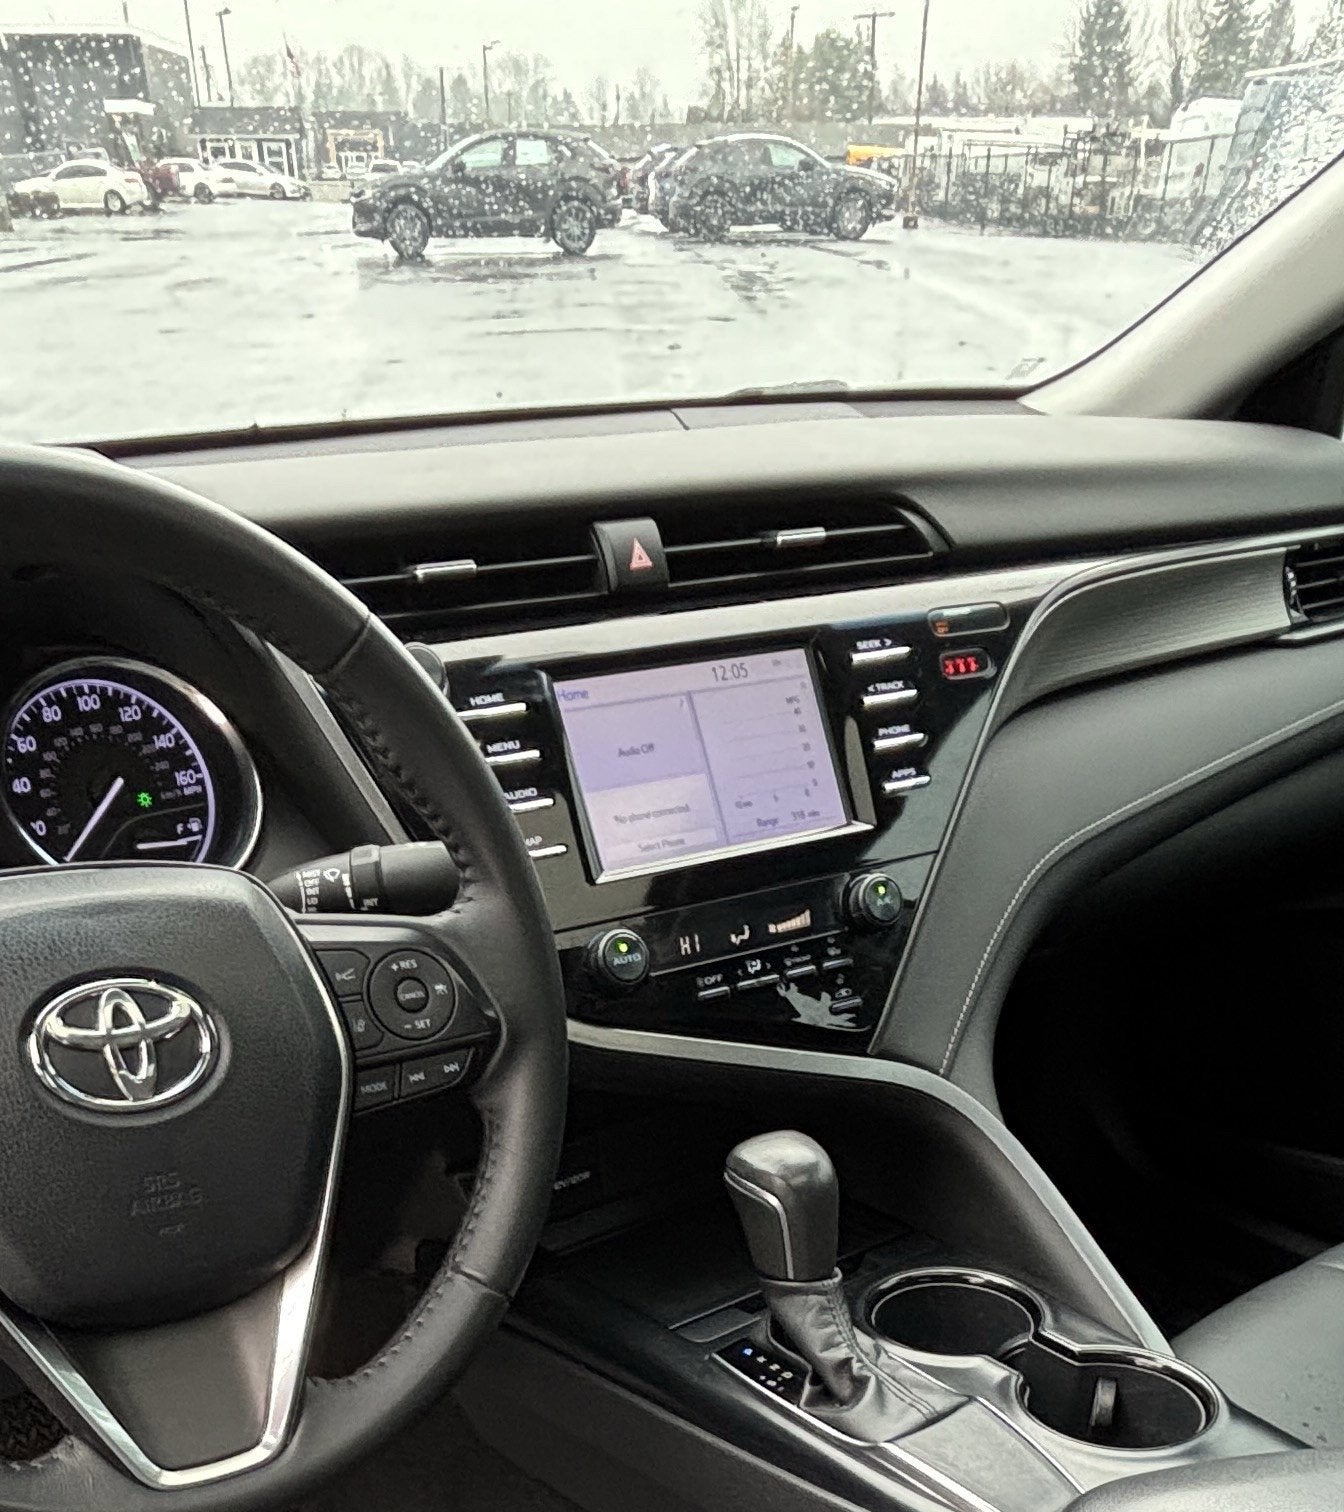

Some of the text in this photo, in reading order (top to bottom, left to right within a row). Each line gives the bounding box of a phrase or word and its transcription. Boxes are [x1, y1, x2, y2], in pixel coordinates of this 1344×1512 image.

[856, 639, 882, 650] SEEK
[876, 680, 904, 692] TRACK
[470, 692, 505, 707] HOME
[557, 687, 589, 702] Home
[77, 693, 102, 712] 100
[42, 705, 62, 723] 80
[118, 704, 142, 723] 120
[878, 724, 911, 737] PHONE
[16, 735, 38, 754] 60
[153, 732, 176, 750] 140
[486, 740, 521, 754] MENU
[175, 768, 197, 786] 160
[891, 768, 917, 780] APPS
[12, 776, 32, 794] 40
[504, 787, 538, 801] AUDIO
[177, 823, 185, 834] F
[679, 933, 701, 956] HI
[399, 959, 418, 971] RES
[612, 952, 642, 968] AUTO
[414, 1018, 432, 1030] SET
[361, 1081, 387, 1094] MODE
